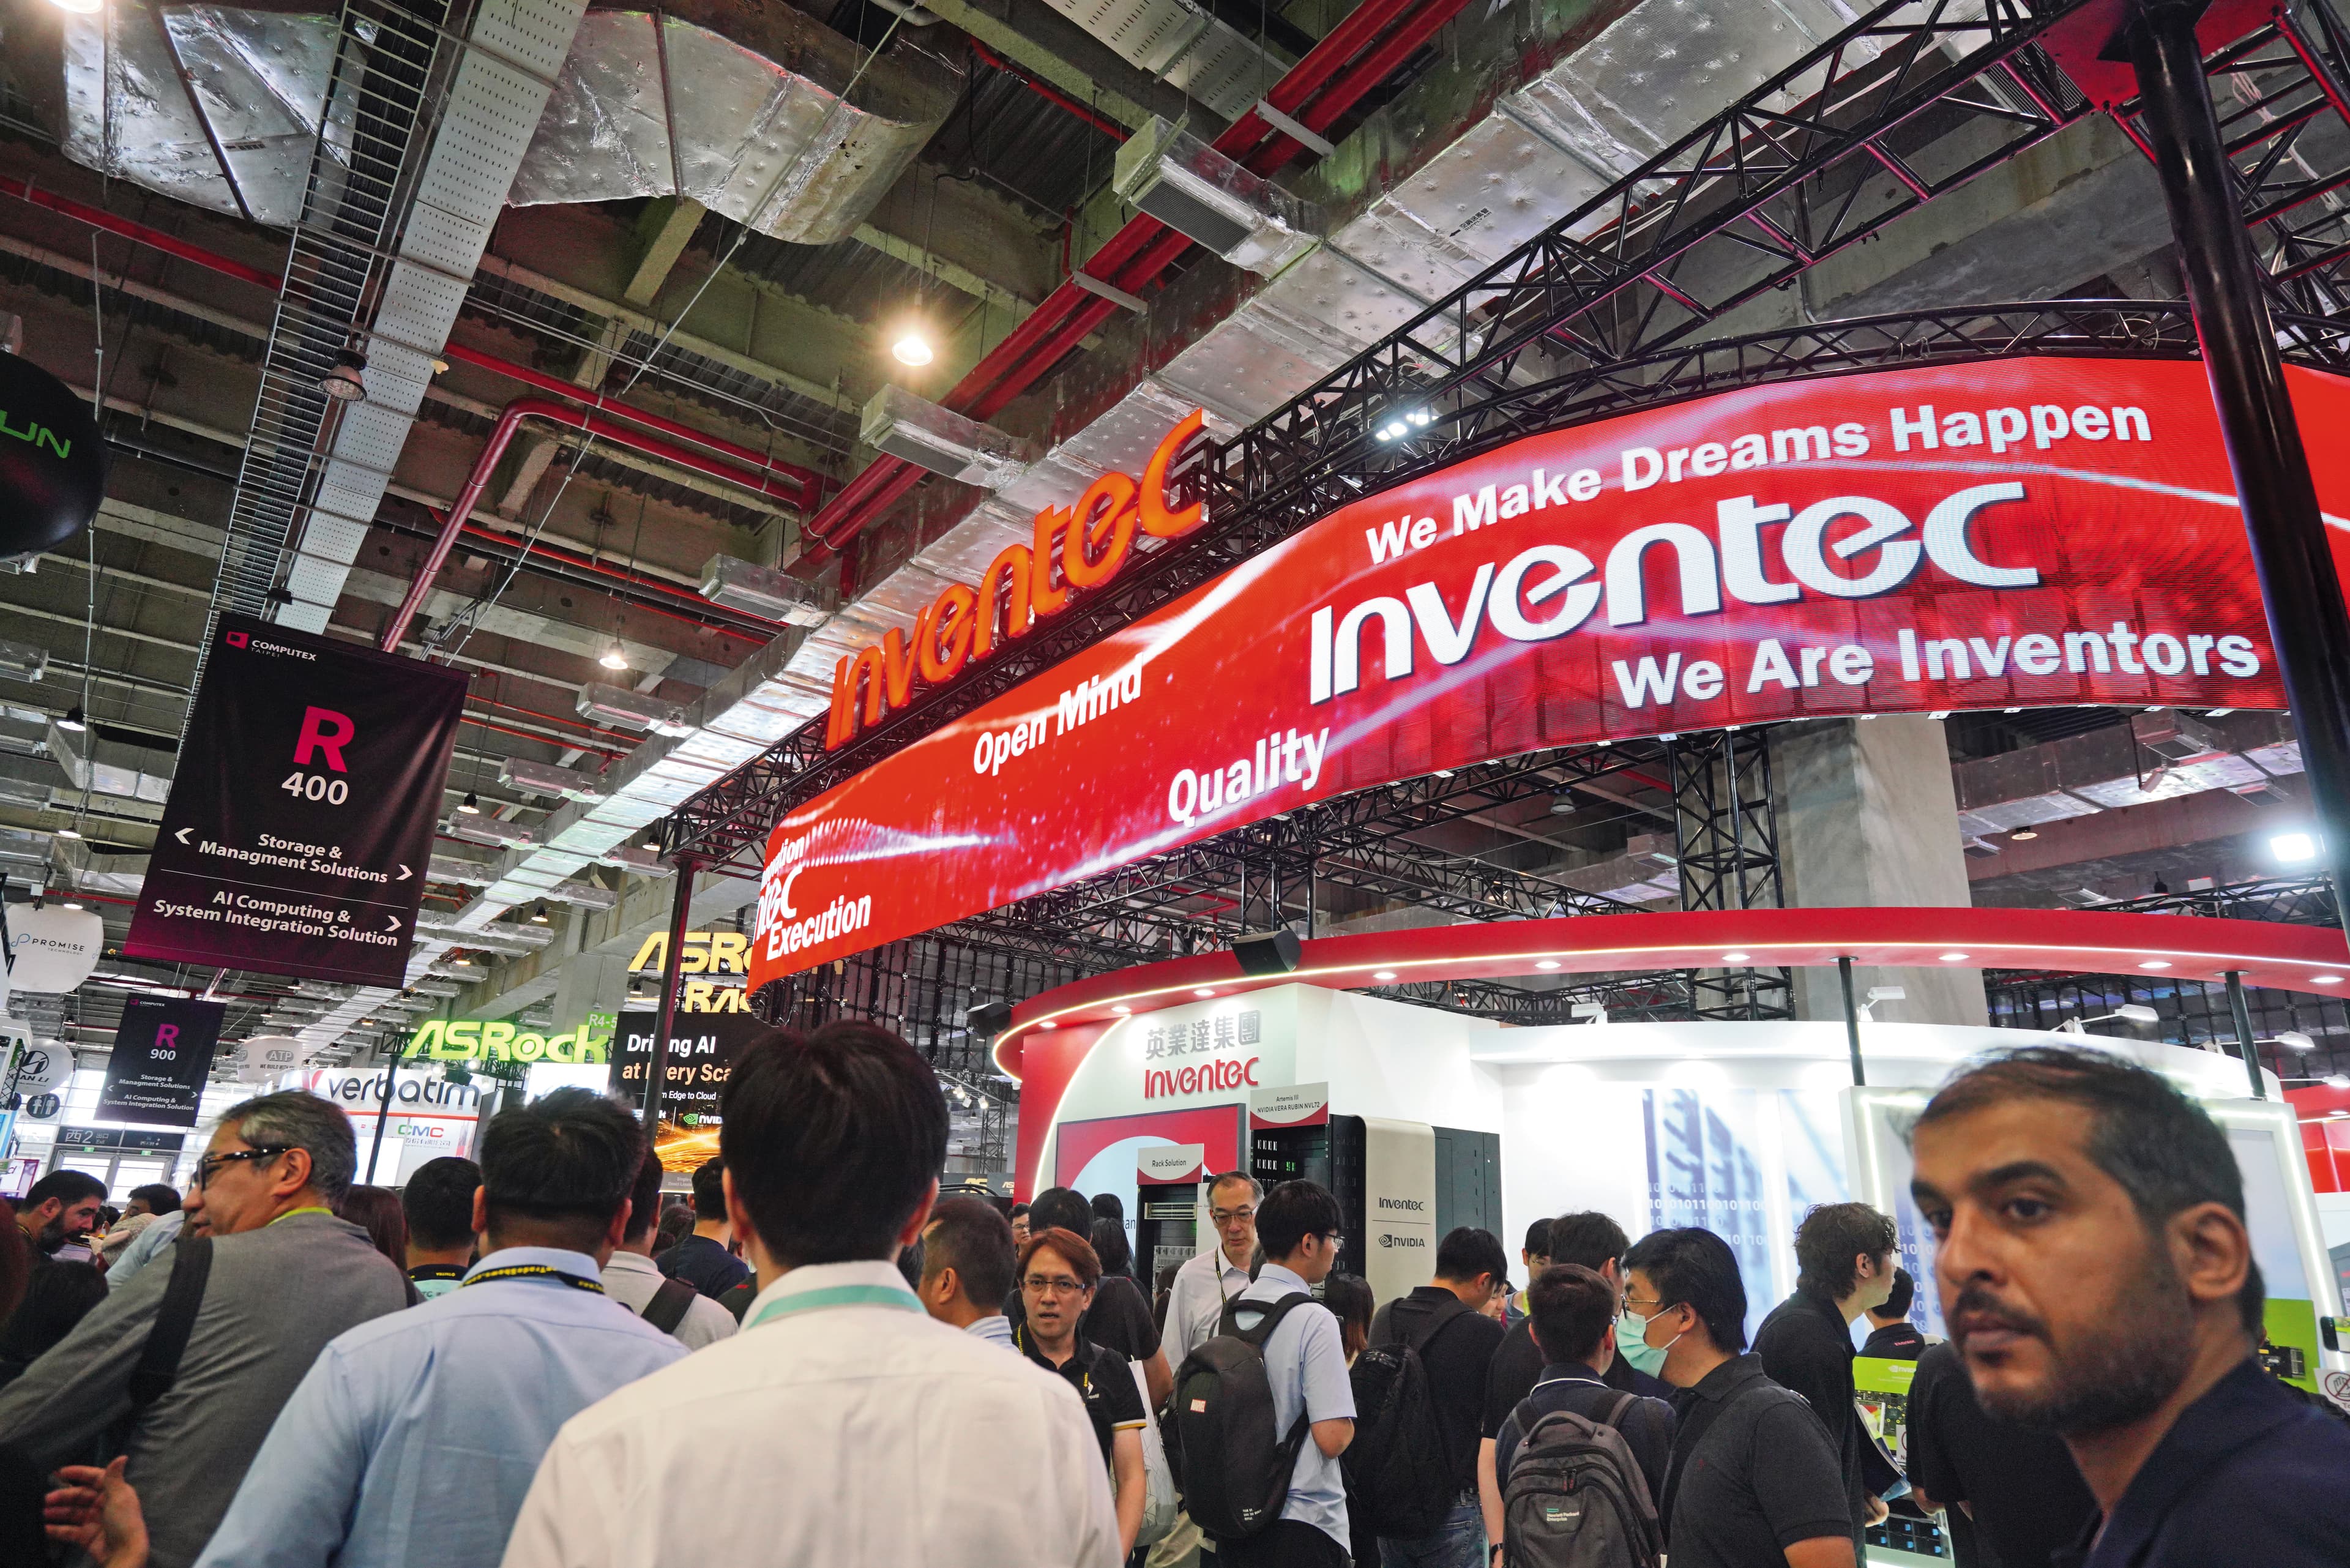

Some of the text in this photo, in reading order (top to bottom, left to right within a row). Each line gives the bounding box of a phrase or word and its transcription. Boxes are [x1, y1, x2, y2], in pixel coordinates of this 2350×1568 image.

[1465, 216, 1483, 230] SUPPLY
[1365, 403, 2152, 565] We Make Dreams Happen
[826, 407, 1207, 752] Inventec
[1310, 482, 2040, 706] Inventec
[250, 648, 280, 658] TAIPEI
[251, 640, 318, 661] COMPUTEX
[1613, 621, 2261, 708] We Are Inventors
[974, 652, 1145, 775] Open Mind
[294, 706, 355, 773] R
[282, 772, 348, 805] 400
[1168, 728, 1329, 829] Quality
[258, 834, 343, 859] Storage &
[199, 840, 388, 883] Managment Solutions
[212, 890, 351, 923] AI Computing &
[154, 900, 398, 946] System Integration Solution
[766, 895, 871, 961] Execution
[32, 938, 85, 952] PROMISE
[627, 931, 753, 973] ASR
[155, 1023, 179, 1048] R
[401, 1020, 610, 1064] ASRock
[627, 1034, 716, 1058] Dring AI
[1146, 1010, 1261, 1061] 英業達集團
[150, 1048, 176, 1061] 900
[269, 1050, 292, 1061] ATP
[119, 1079, 159, 1088] Managment
[622, 1062, 641, 1079] at
[645, 1062, 696, 1085] ery
[1145, 1057, 1259, 1099] Inventec
[133, 1095, 169, 1103] Computing
[329, 1073, 480, 1107] verbatim
[669, 1091, 685, 1100] Edge
[696, 1091, 716, 1100] Cloud
[398, 1124, 444, 1138] CMC
[699, 1115, 723, 1124] NVID
[1379, 1197, 1424, 1211] Inventec
[1394, 1237, 1425, 1247] NVIDIA
